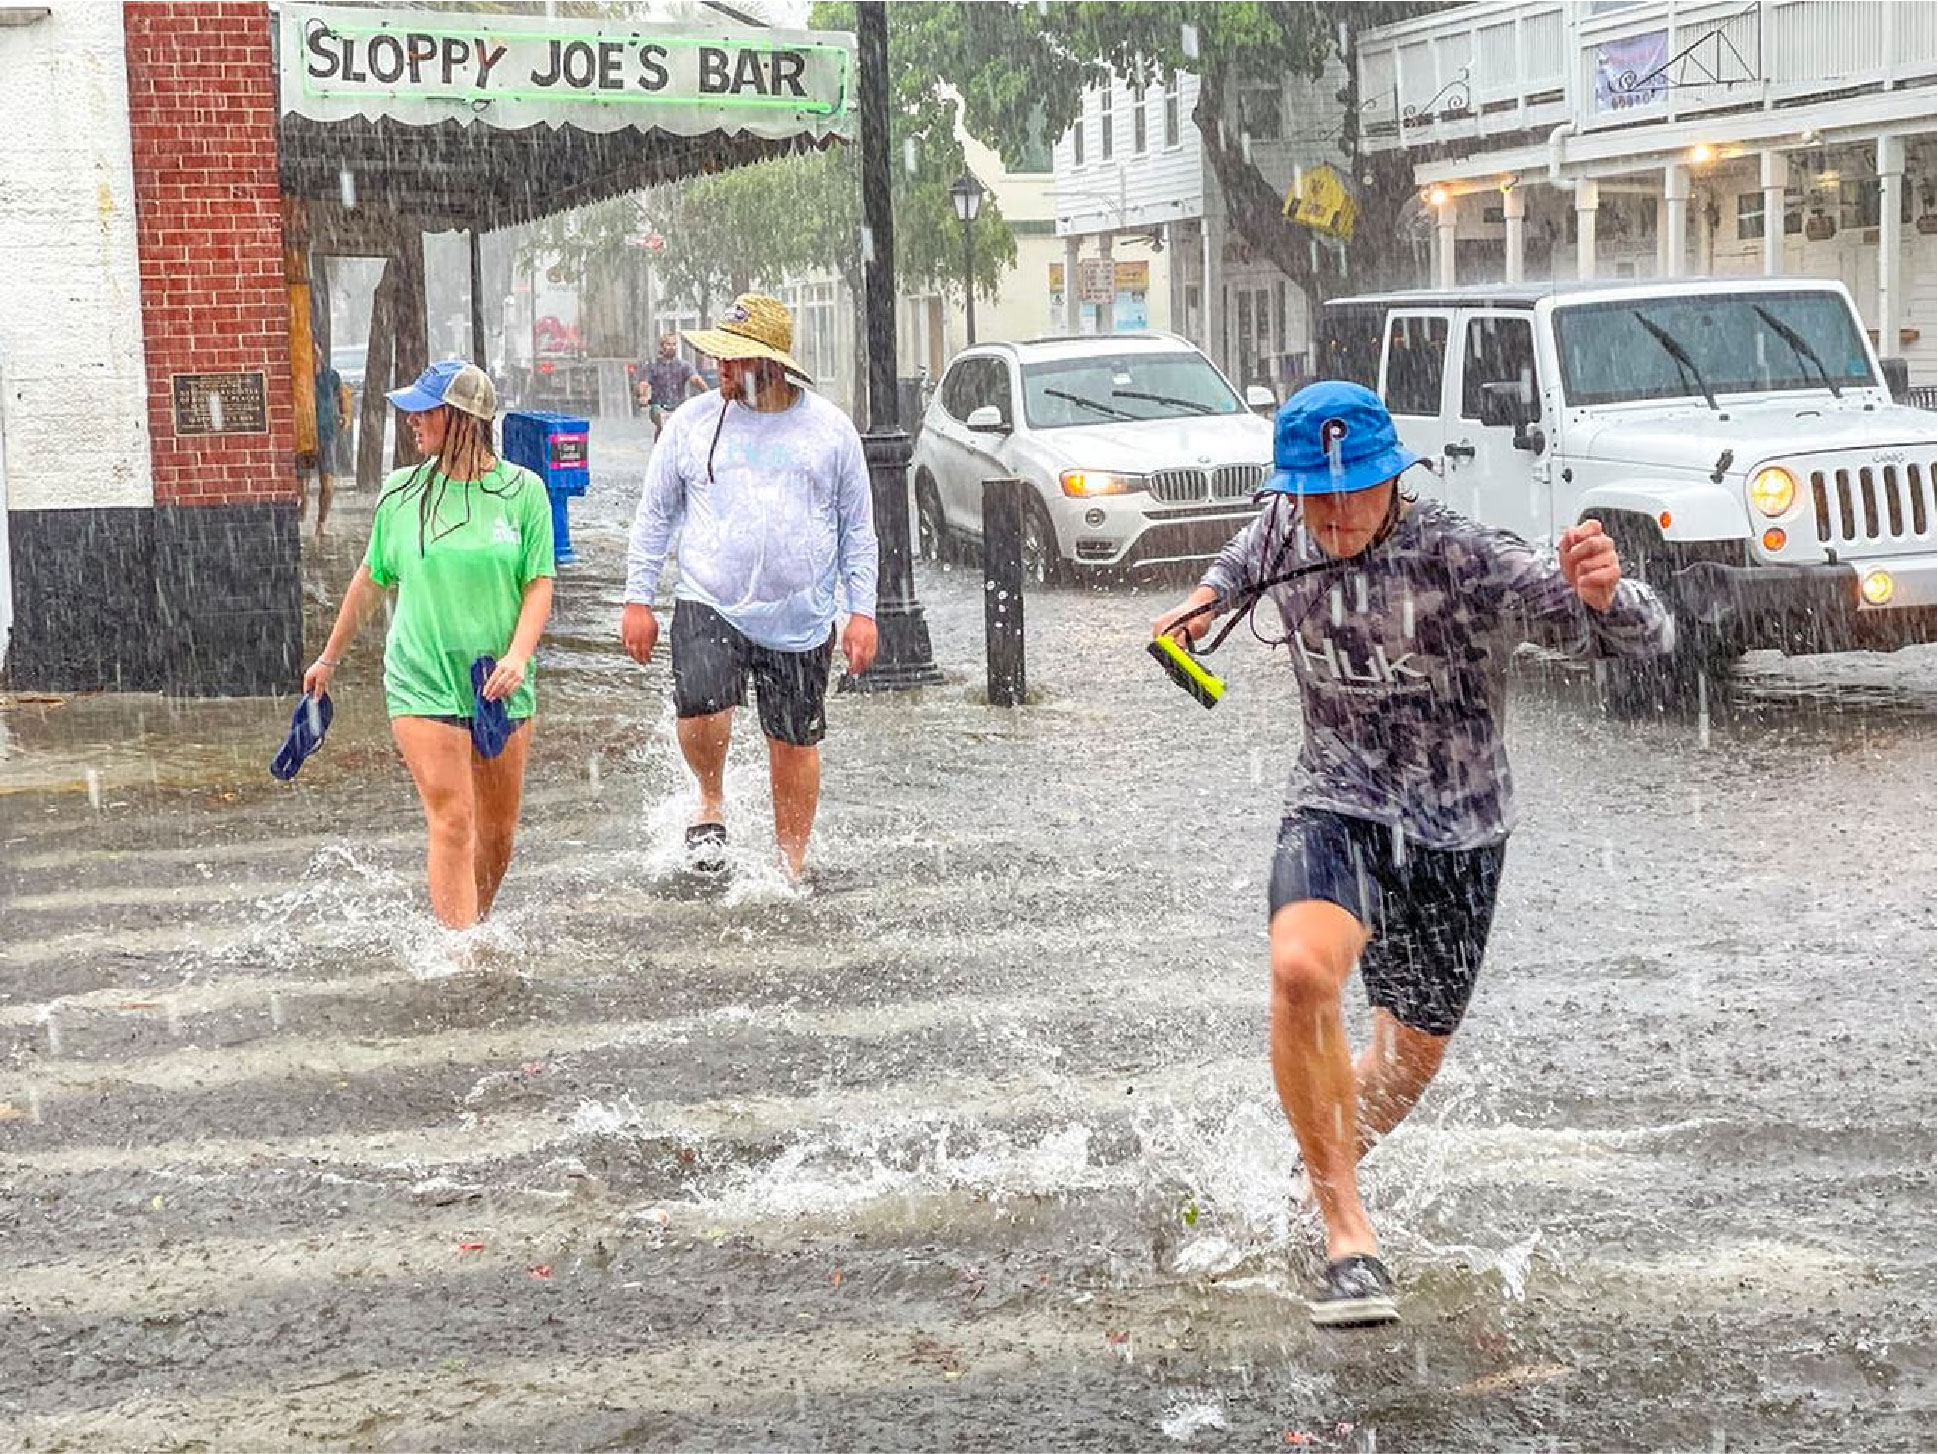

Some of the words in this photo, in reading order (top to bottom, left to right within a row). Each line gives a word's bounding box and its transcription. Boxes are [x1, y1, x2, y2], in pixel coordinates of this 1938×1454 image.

[308, 28, 507, 89] SLOPPY
[531, 34, 669, 91] JOE'S
[699, 45, 807, 97] BAR
[1320, 417, 1348, 455] P
[1295, 631, 1426, 682] HUK
